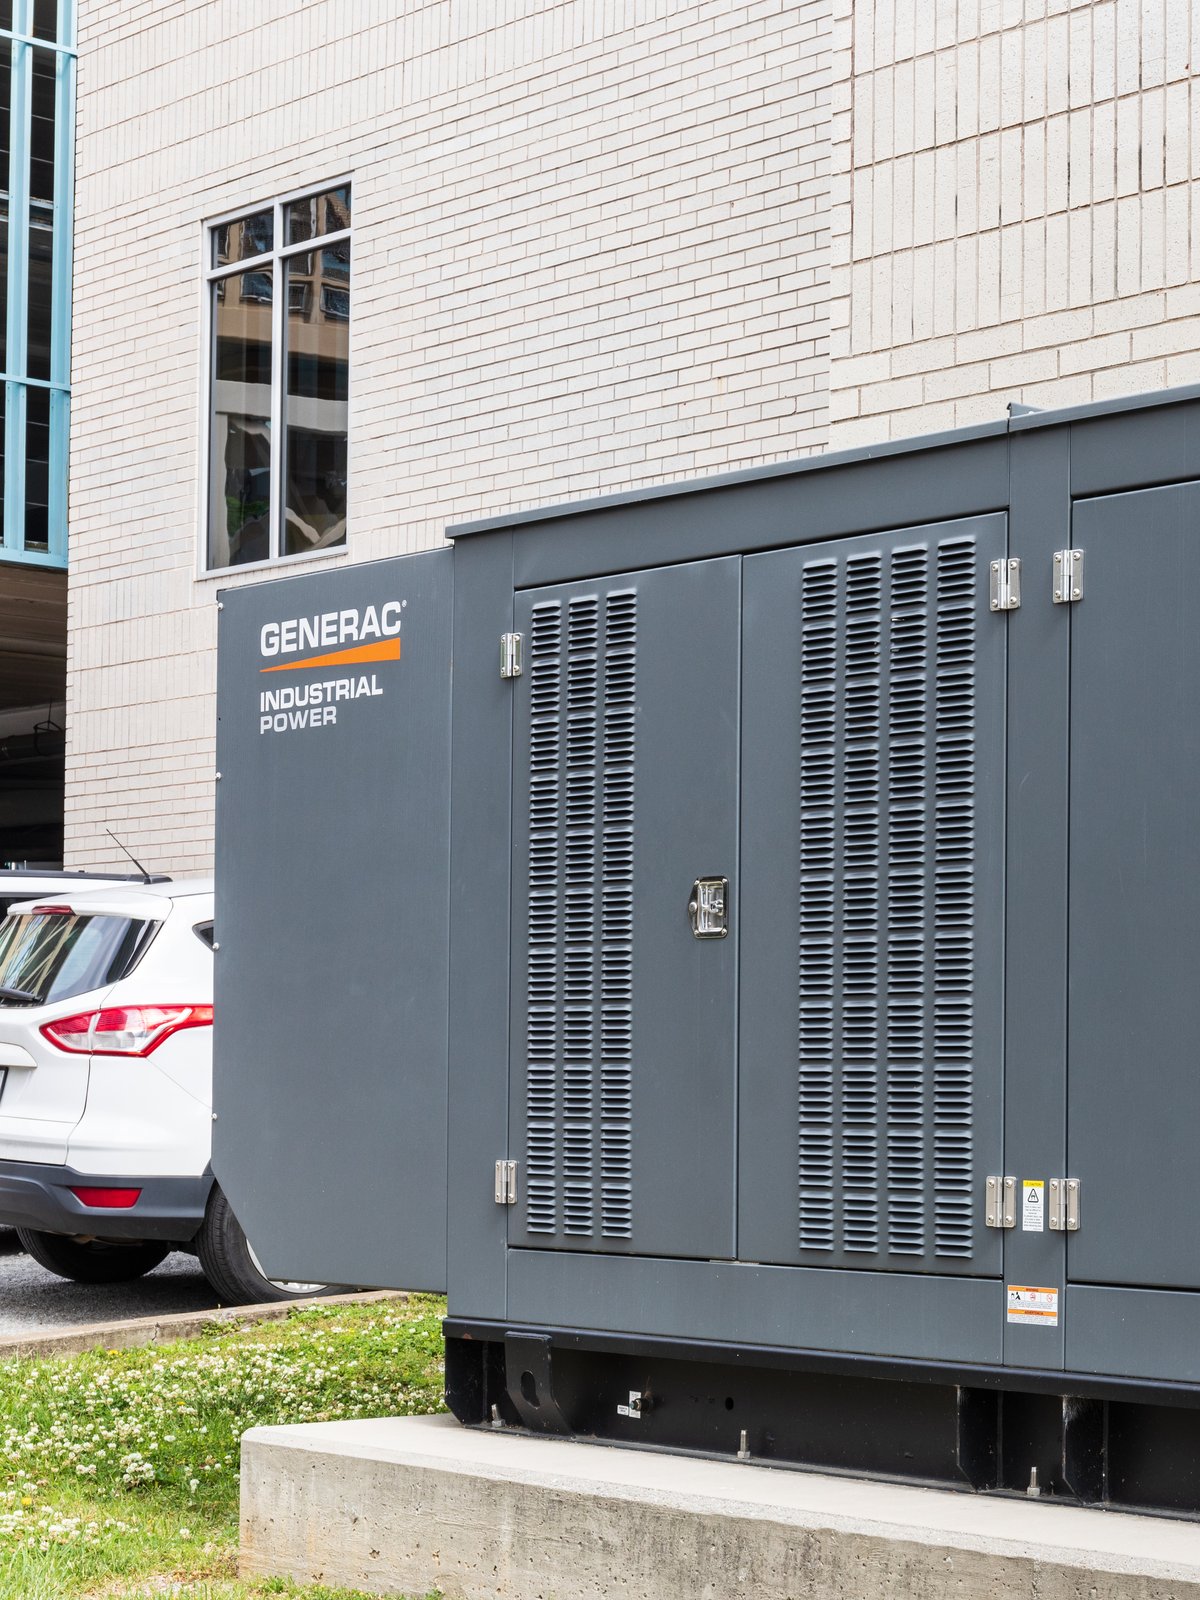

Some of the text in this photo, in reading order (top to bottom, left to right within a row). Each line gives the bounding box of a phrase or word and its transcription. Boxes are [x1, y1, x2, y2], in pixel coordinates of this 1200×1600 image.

[260, 599, 401, 657] GENERAC
[259, 675, 383, 713] INDUSTRIAL
[259, 705, 337, 736] POWER
